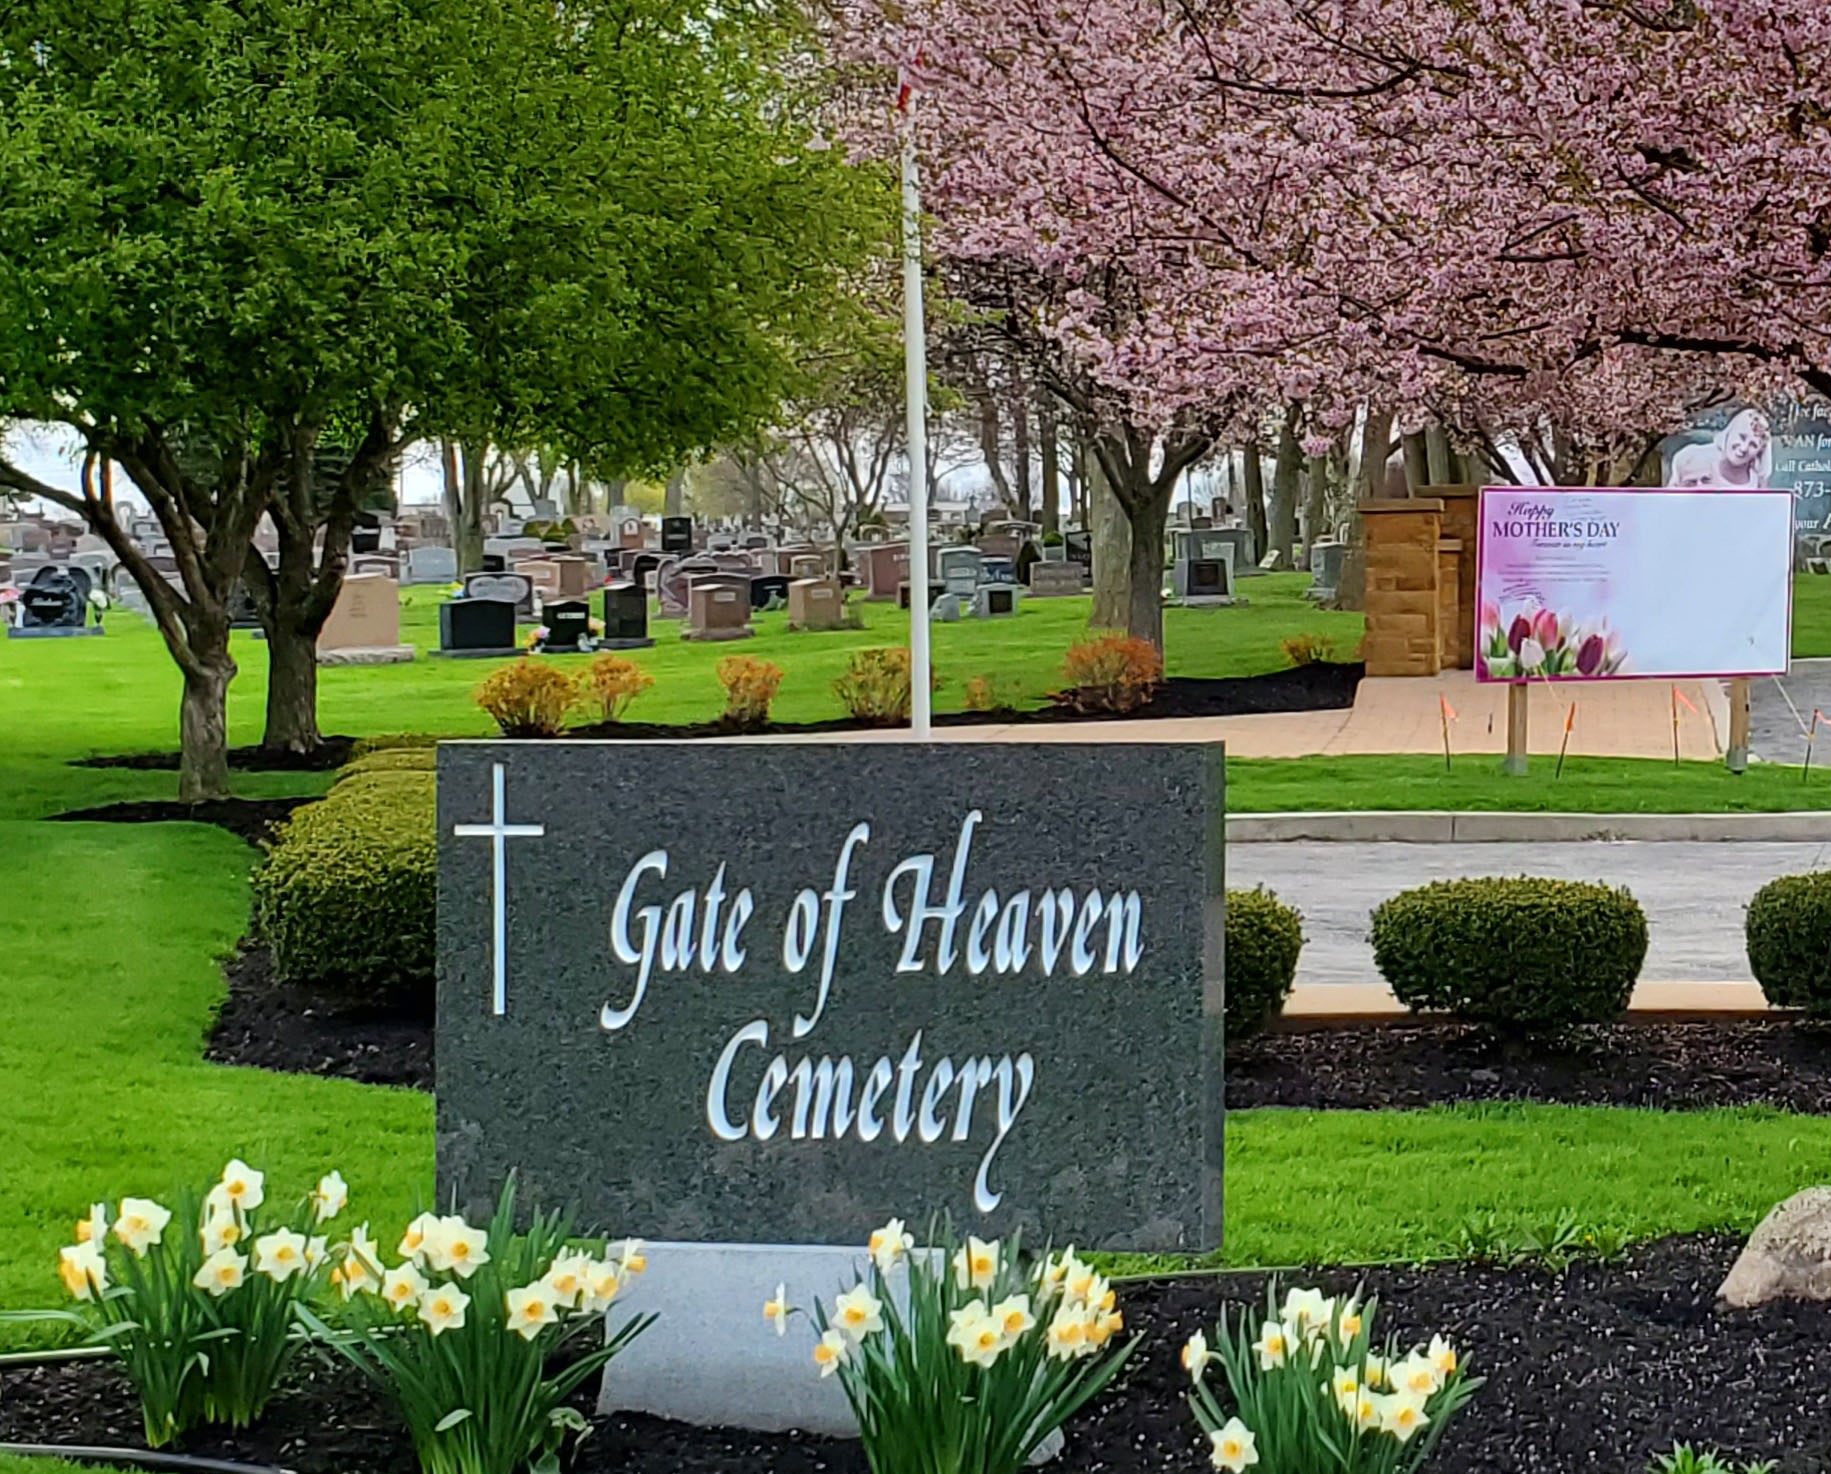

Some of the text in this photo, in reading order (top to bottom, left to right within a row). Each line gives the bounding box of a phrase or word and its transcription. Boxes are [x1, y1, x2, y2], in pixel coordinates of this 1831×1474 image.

[1492, 521, 1620, 538] MOTHER'S DAY
[1507, 501, 1555, 521] Happy
[601, 810, 1144, 1037] Gate of Heaven
[707, 1019, 1033, 1213] Cemetery
